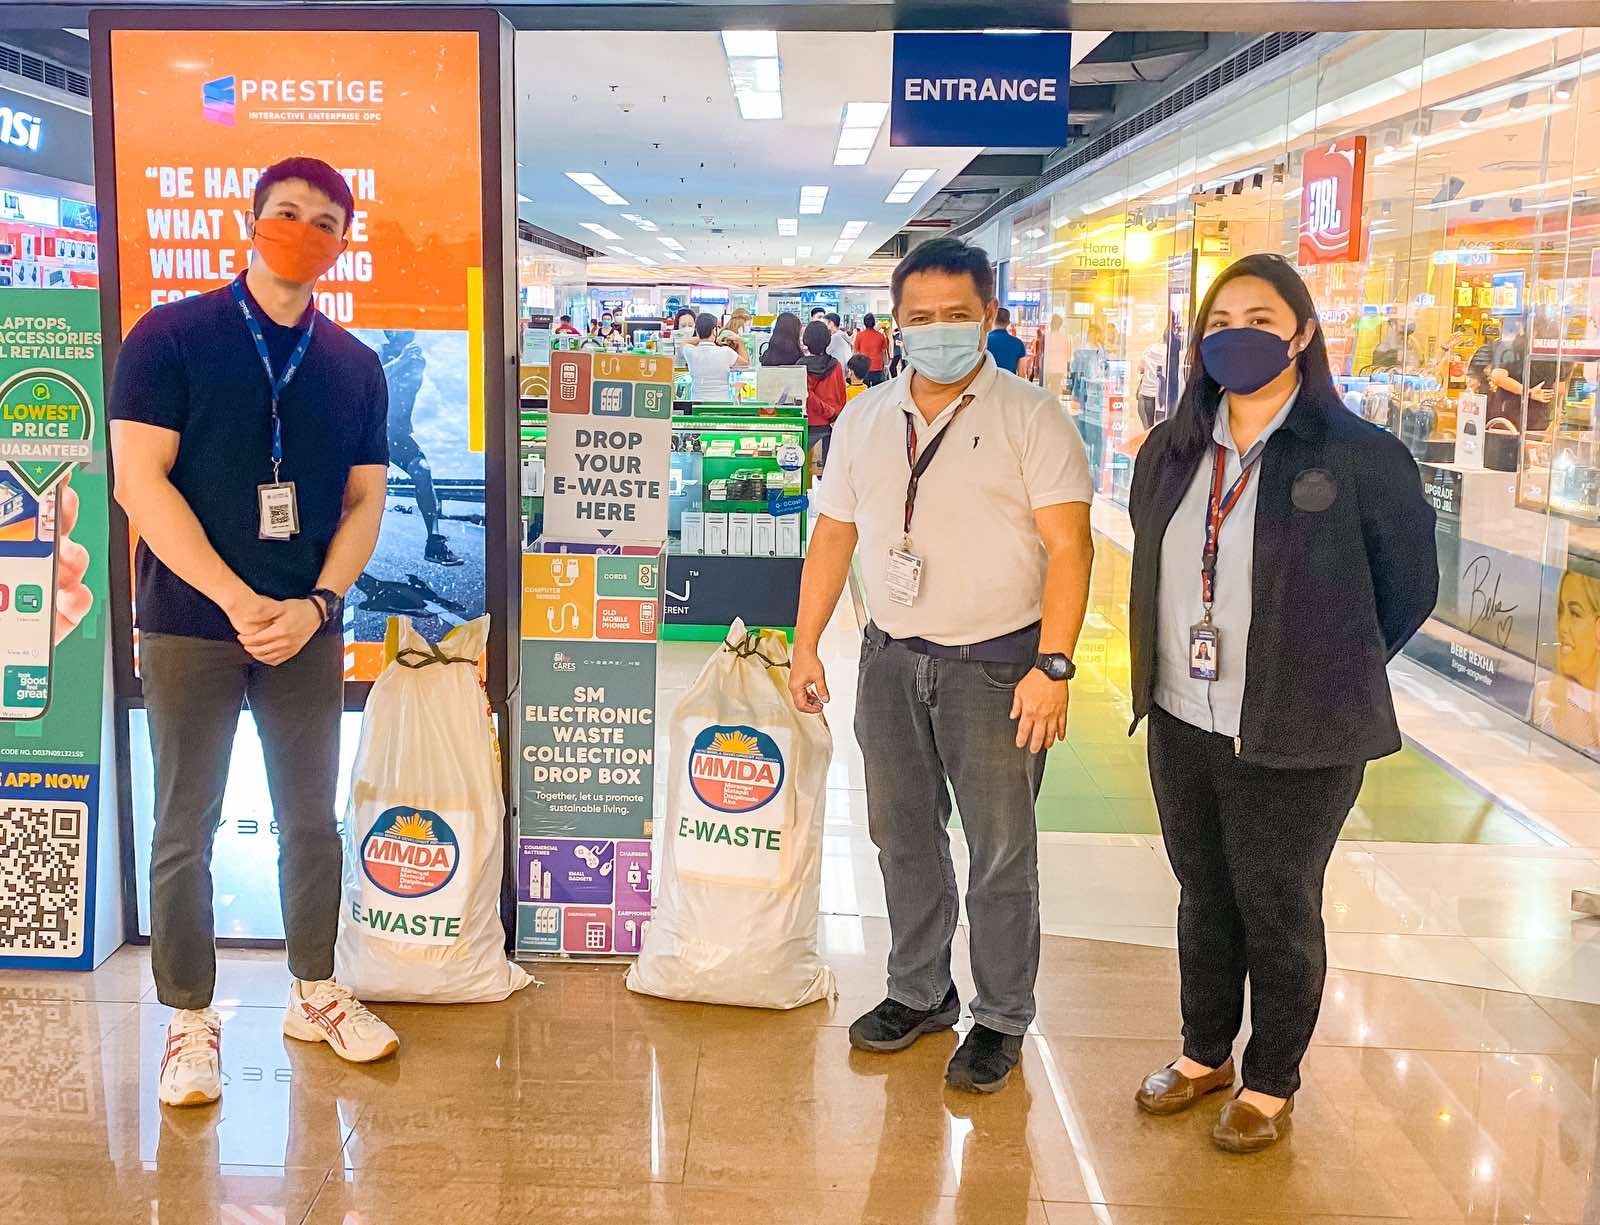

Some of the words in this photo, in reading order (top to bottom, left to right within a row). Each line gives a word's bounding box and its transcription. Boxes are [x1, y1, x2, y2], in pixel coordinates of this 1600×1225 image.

[241, 79, 384, 103] PRESTIGE
[904, 78, 1057, 102] ENTRANCE
[249, 112, 305, 121] INTERACTIVE
[308, 112, 360, 121] ENTERPRISE
[1309, 176, 1342, 234] JBL
[147, 208, 224, 240] WHAT
[1083, 243, 1119, 254] Home
[149, 248, 237, 280] WHILE
[1076, 255, 1122, 267] Theatre
[11, 346, 95, 359] RETAILERS
[3, 404, 81, 422] LOWEST
[11, 422, 69, 437] PRICE
[575, 429, 643, 450] DROP
[575, 453, 641, 474] YOUR
[553, 477, 660, 499] E-WASTE
[1424, 482, 1453, 500] UPGRADE
[576, 502, 636, 522] HERE
[1432, 496, 1441, 510] TO
[1441, 500, 1453, 513] JBL
[553, 662, 576, 670] CARES
[1450, 640, 1468, 661] BEBE
[1468, 650, 1495, 675] REXHA
[16, 689, 48, 700] great
[573, 686, 605, 704] SM
[525, 705, 653, 725] ELECTRONIC
[553, 726, 624, 744] WASTE
[523, 746, 653, 765] COLLECTION
[534, 767, 592, 783] DROP
[598, 768, 641, 785] BOX
[694, 755, 775, 785] MMDA
[4, 772, 43, 788] APP
[45, 773, 90, 789] NOW
[535, 790, 578, 802] Together,
[579, 792, 592, 801] let
[605, 793, 644, 804] promote
[549, 803, 601, 813] sustainable
[602, 804, 630, 815] living.
[679, 817, 782, 850] E-WASTE
[367, 839, 450, 868] MMDA
[352, 901, 461, 937] E-WASTE
